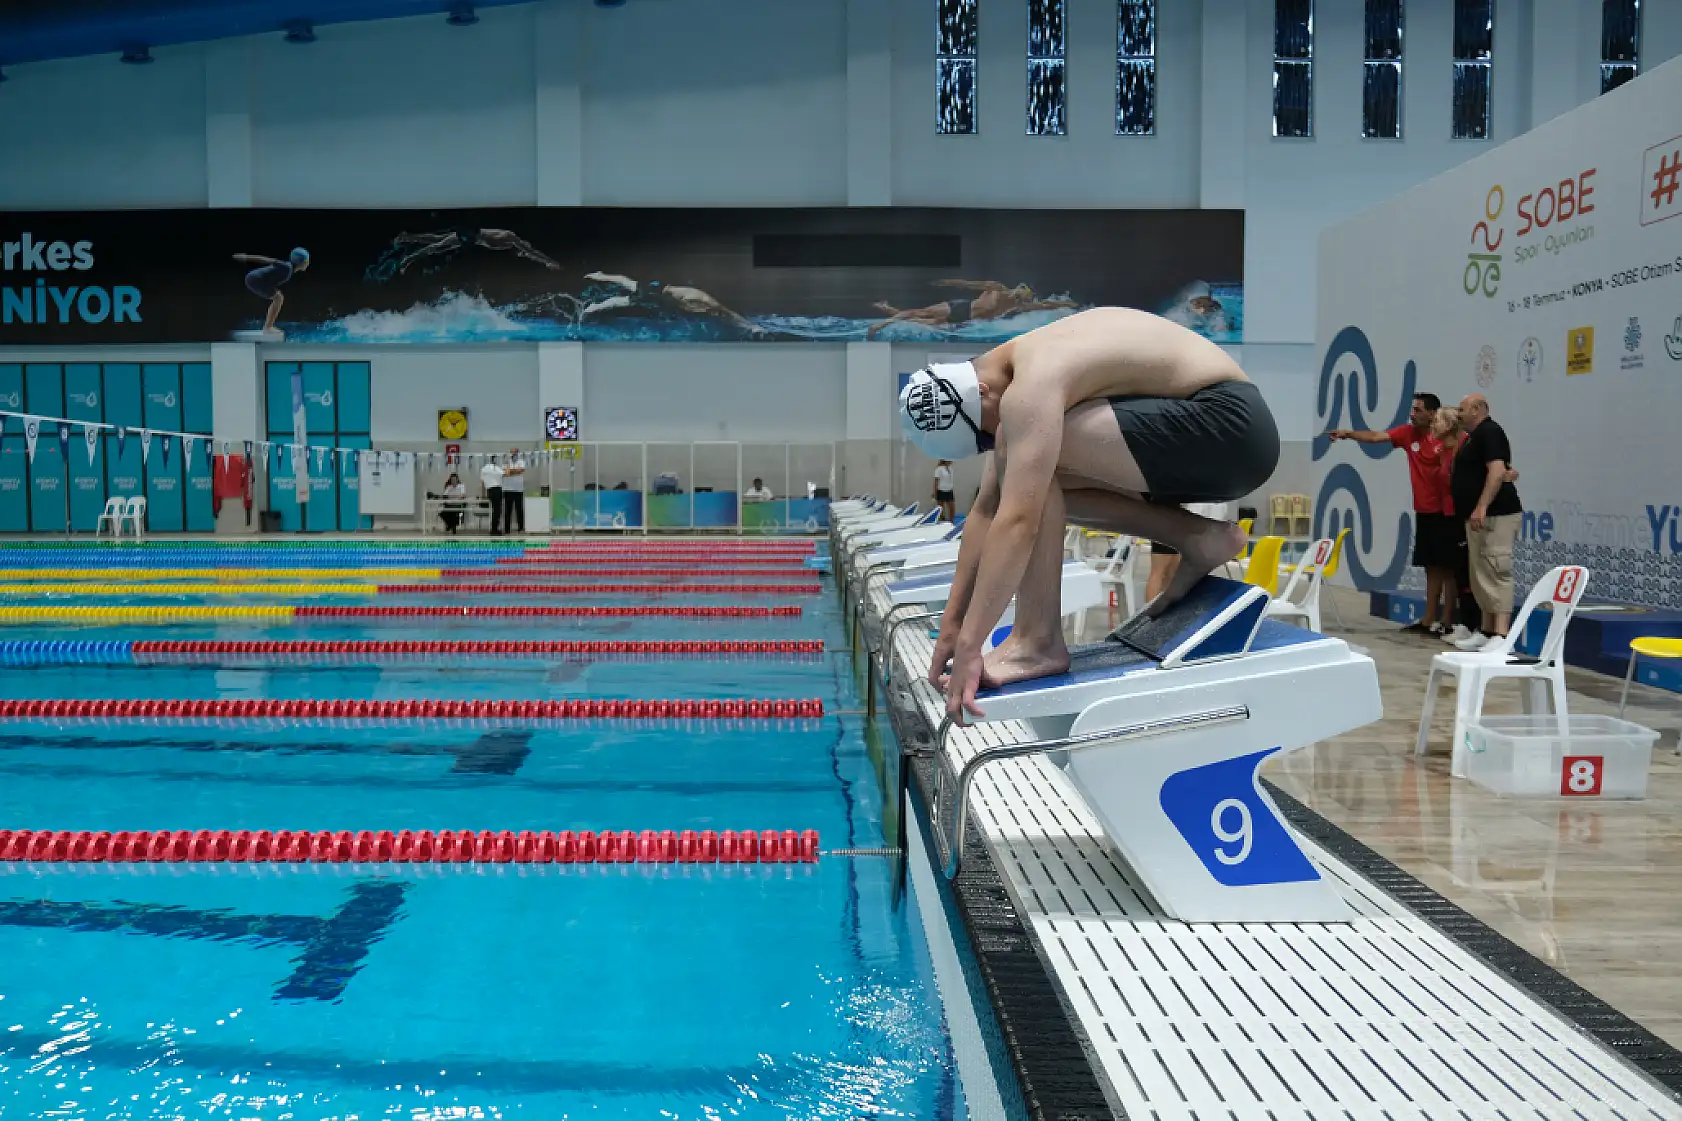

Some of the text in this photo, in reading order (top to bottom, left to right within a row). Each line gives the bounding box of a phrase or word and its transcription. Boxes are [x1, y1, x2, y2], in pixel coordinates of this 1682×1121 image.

[1516, 168, 1597, 237] SOBE
[0, 231, 95, 271] rkes
[1514, 243, 1541, 265] Spor
[1572, 278, 1603, 298] KONYA
[1611, 267, 1638, 288] SOBE
[1640, 262, 1673, 281] Otizm
[2, 277, 144, 324] NİYOR
[1558, 571, 1576, 599] 8
[1569, 760, 1595, 792] 8
[1211, 798, 1253, 866] 9
